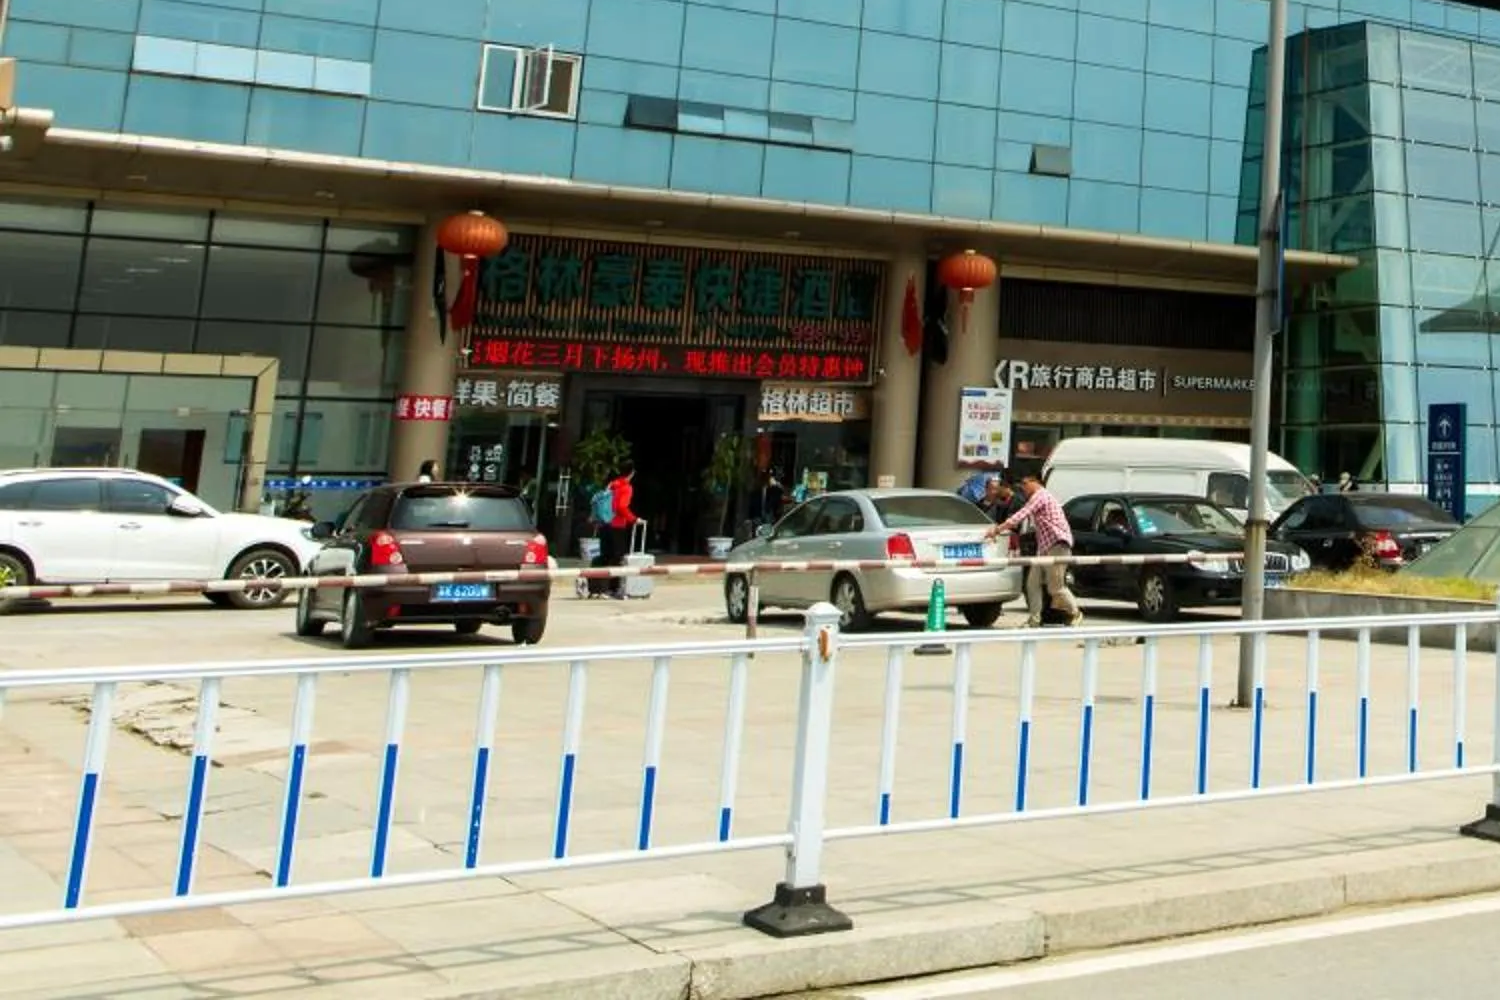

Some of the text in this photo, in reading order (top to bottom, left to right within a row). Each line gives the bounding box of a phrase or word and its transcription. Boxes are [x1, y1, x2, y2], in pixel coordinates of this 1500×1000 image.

[1031, 364, 1157, 392] 旅行商品超市
[1173, 375, 1256, 391] SUPERMARKE
[761, 387, 854, 417] 格林超市
